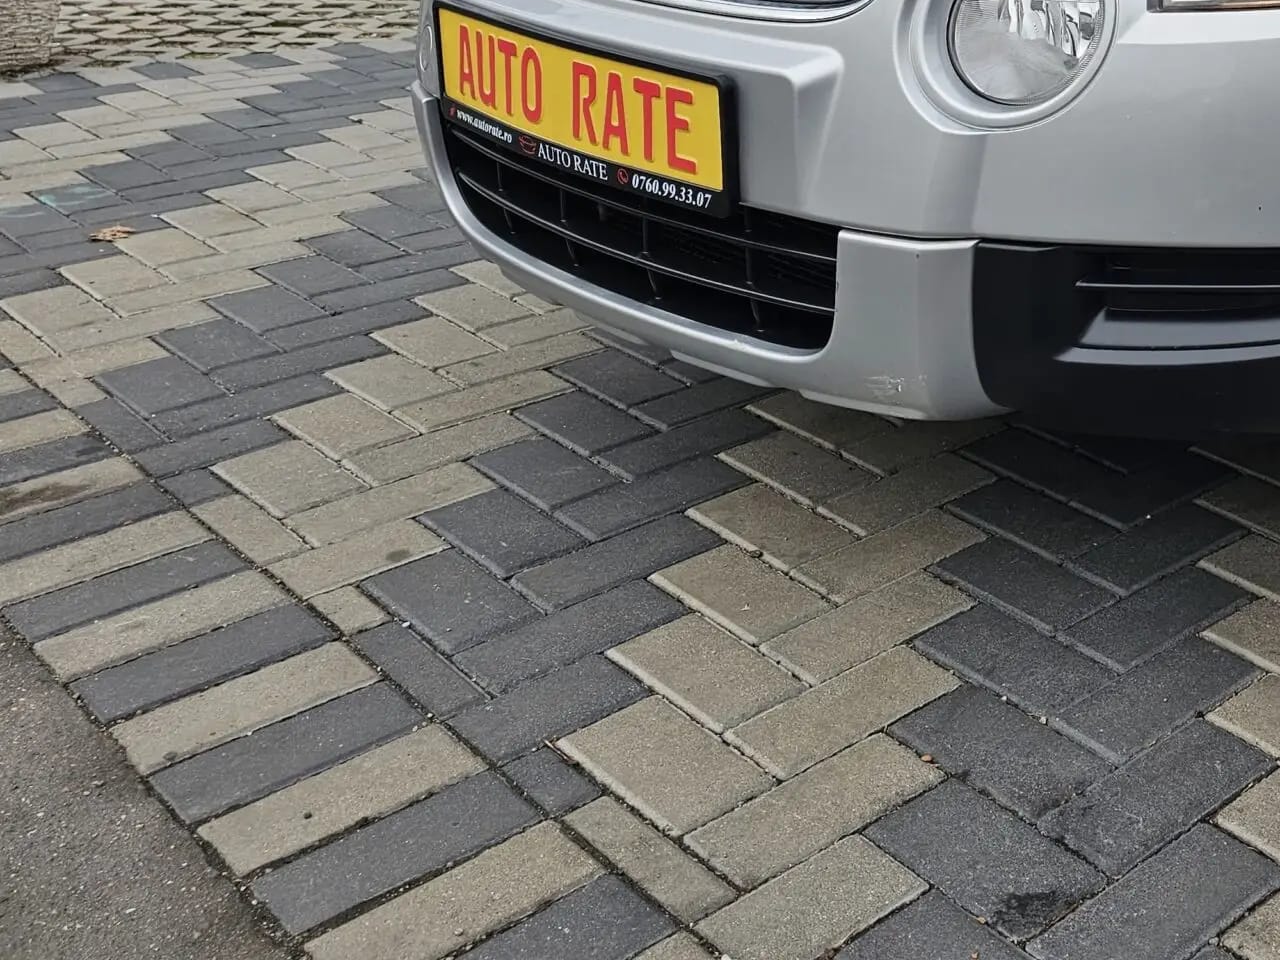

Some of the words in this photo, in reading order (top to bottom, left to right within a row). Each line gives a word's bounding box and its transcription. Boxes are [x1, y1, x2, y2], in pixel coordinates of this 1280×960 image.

[457, 109, 513, 144] www.autorate.ro
[538, 143, 571, 168] AUTO
[573, 155, 608, 181] RATE
[631, 173, 712, 209] 0760.99.33.07
[458, 24, 543, 124] AUTO
[571, 60, 698, 176] RATE
